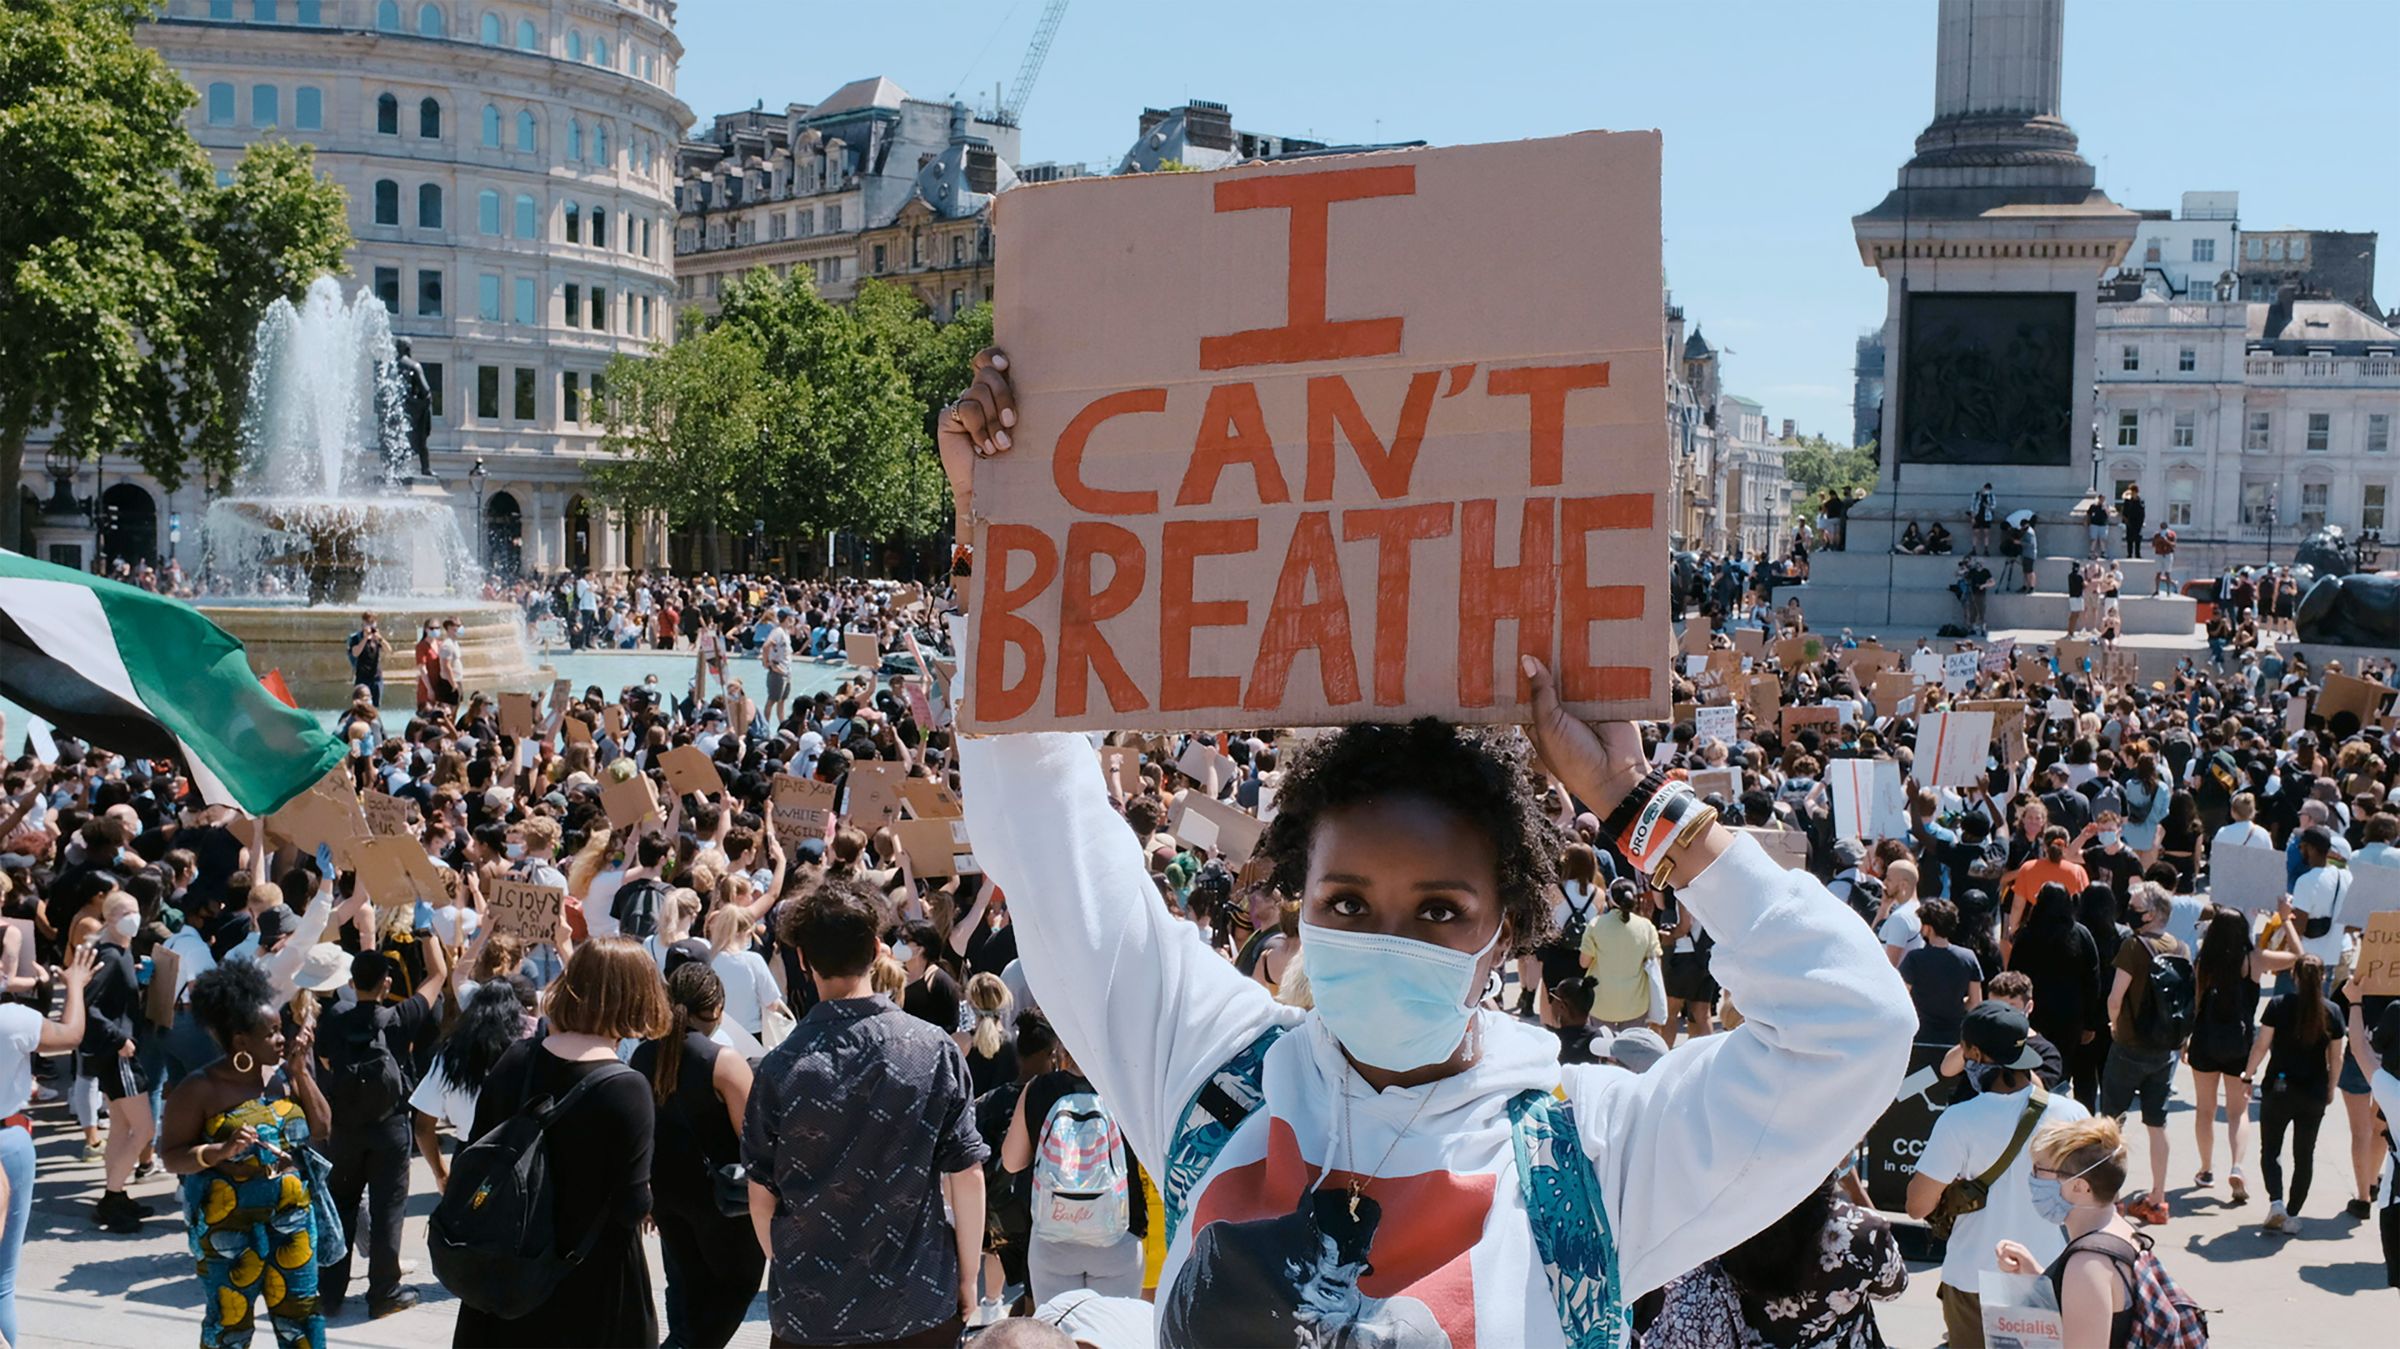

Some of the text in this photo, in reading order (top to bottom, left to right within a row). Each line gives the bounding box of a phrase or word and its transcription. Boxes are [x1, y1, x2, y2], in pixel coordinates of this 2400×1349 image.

[1200, 164, 1416, 370] I
[1052, 361, 1611, 515] CAN'T
[975, 493, 1655, 722] BREATHE
[774, 804, 820, 823] WHITE
[491, 885, 560, 916] RACIST
[516, 910, 539, 923] IS A
[1998, 1315, 2058, 1337] Socialist
